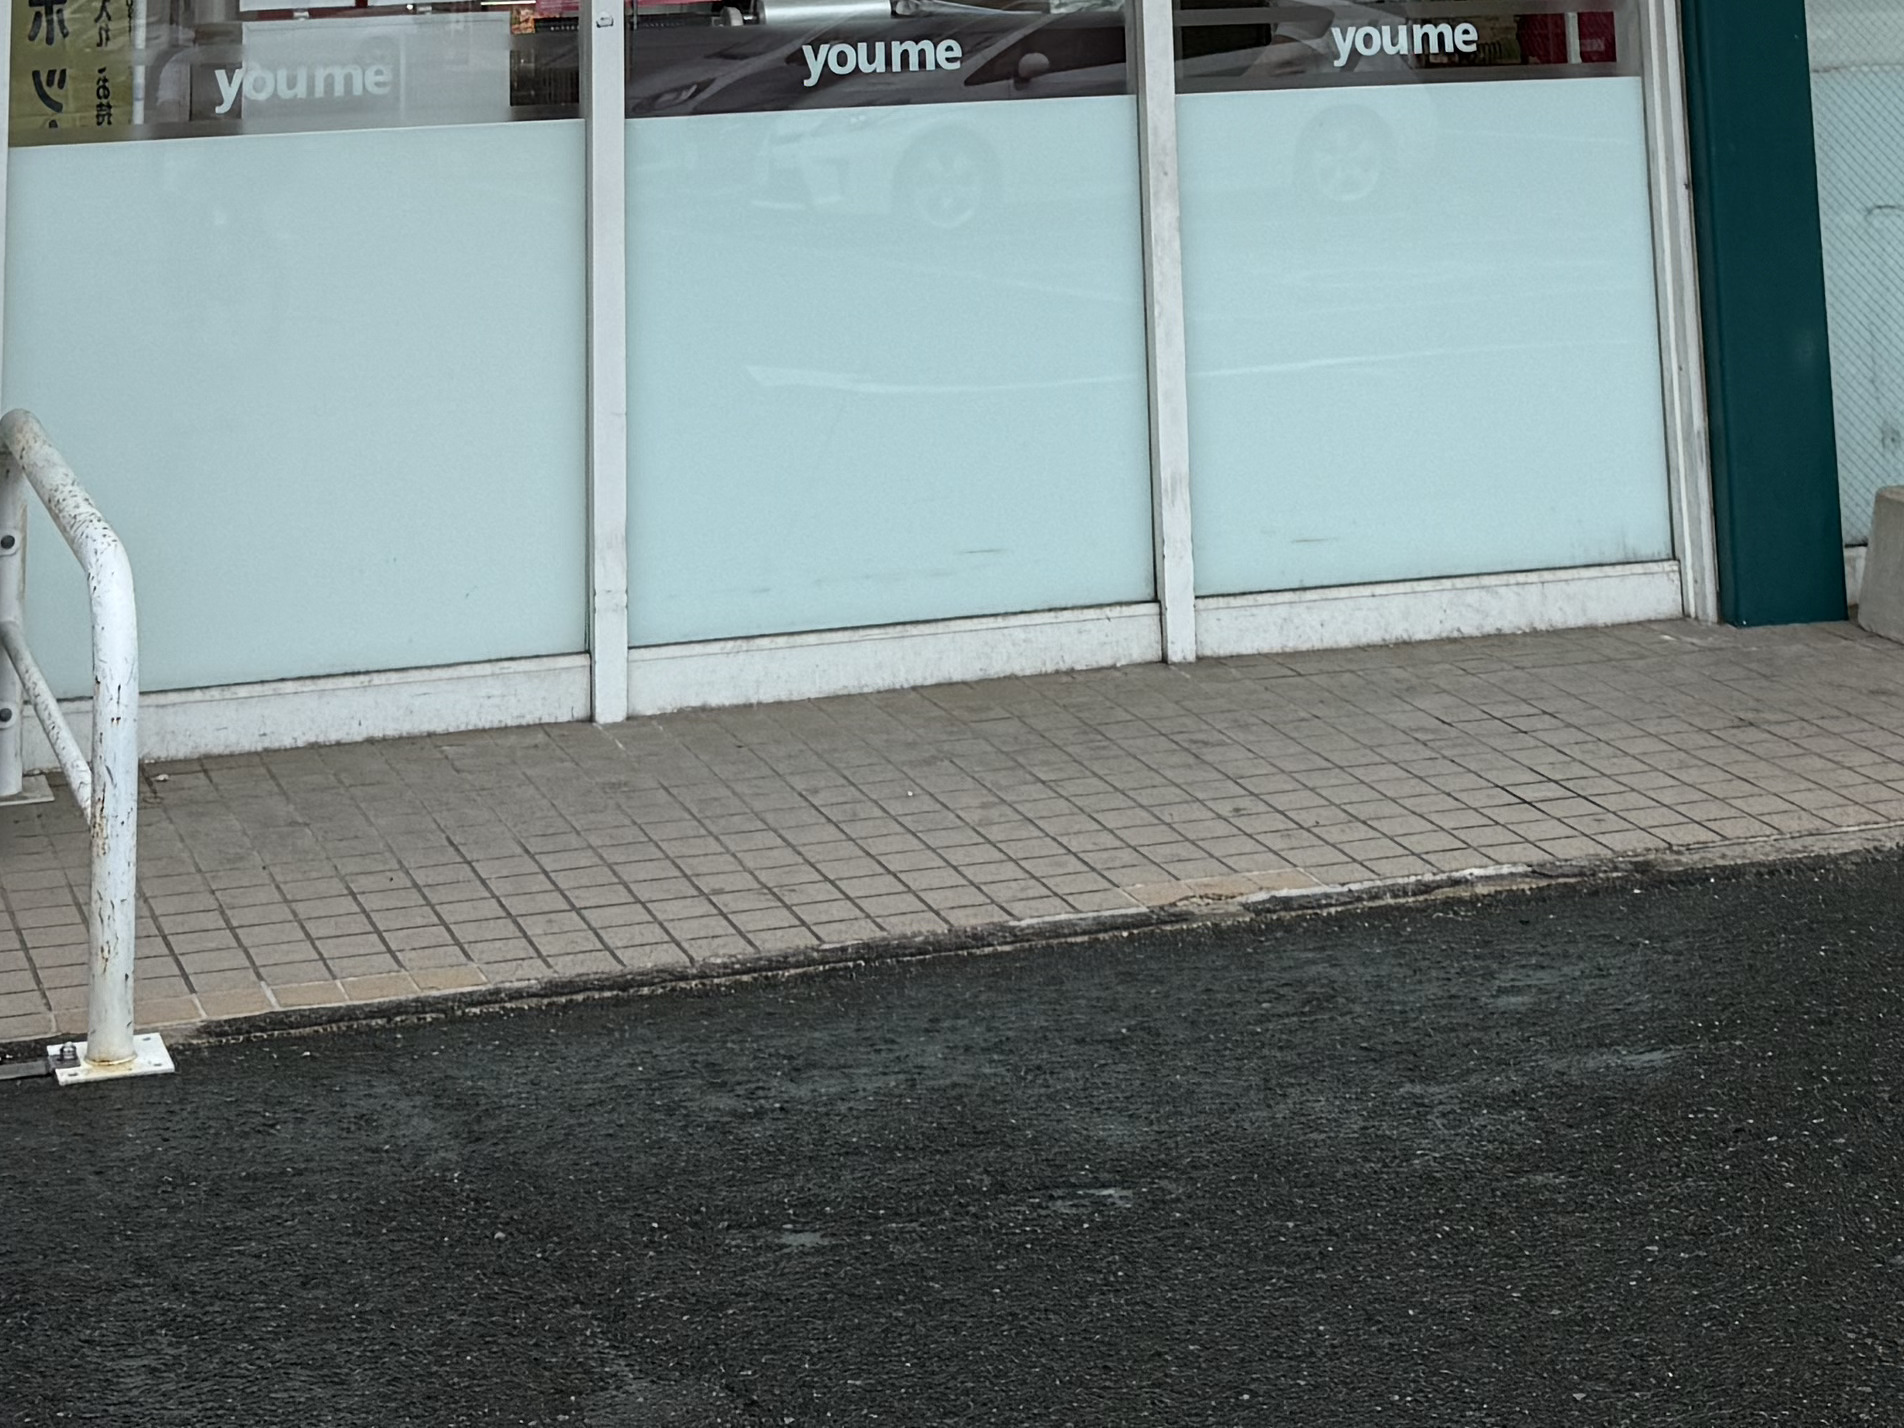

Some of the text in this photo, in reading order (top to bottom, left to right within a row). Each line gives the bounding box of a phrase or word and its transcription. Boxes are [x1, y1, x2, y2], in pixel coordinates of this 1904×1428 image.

[801, 38, 963, 87] youme
[1330, 21, 1479, 68] youme
[215, 63, 393, 114] youme
